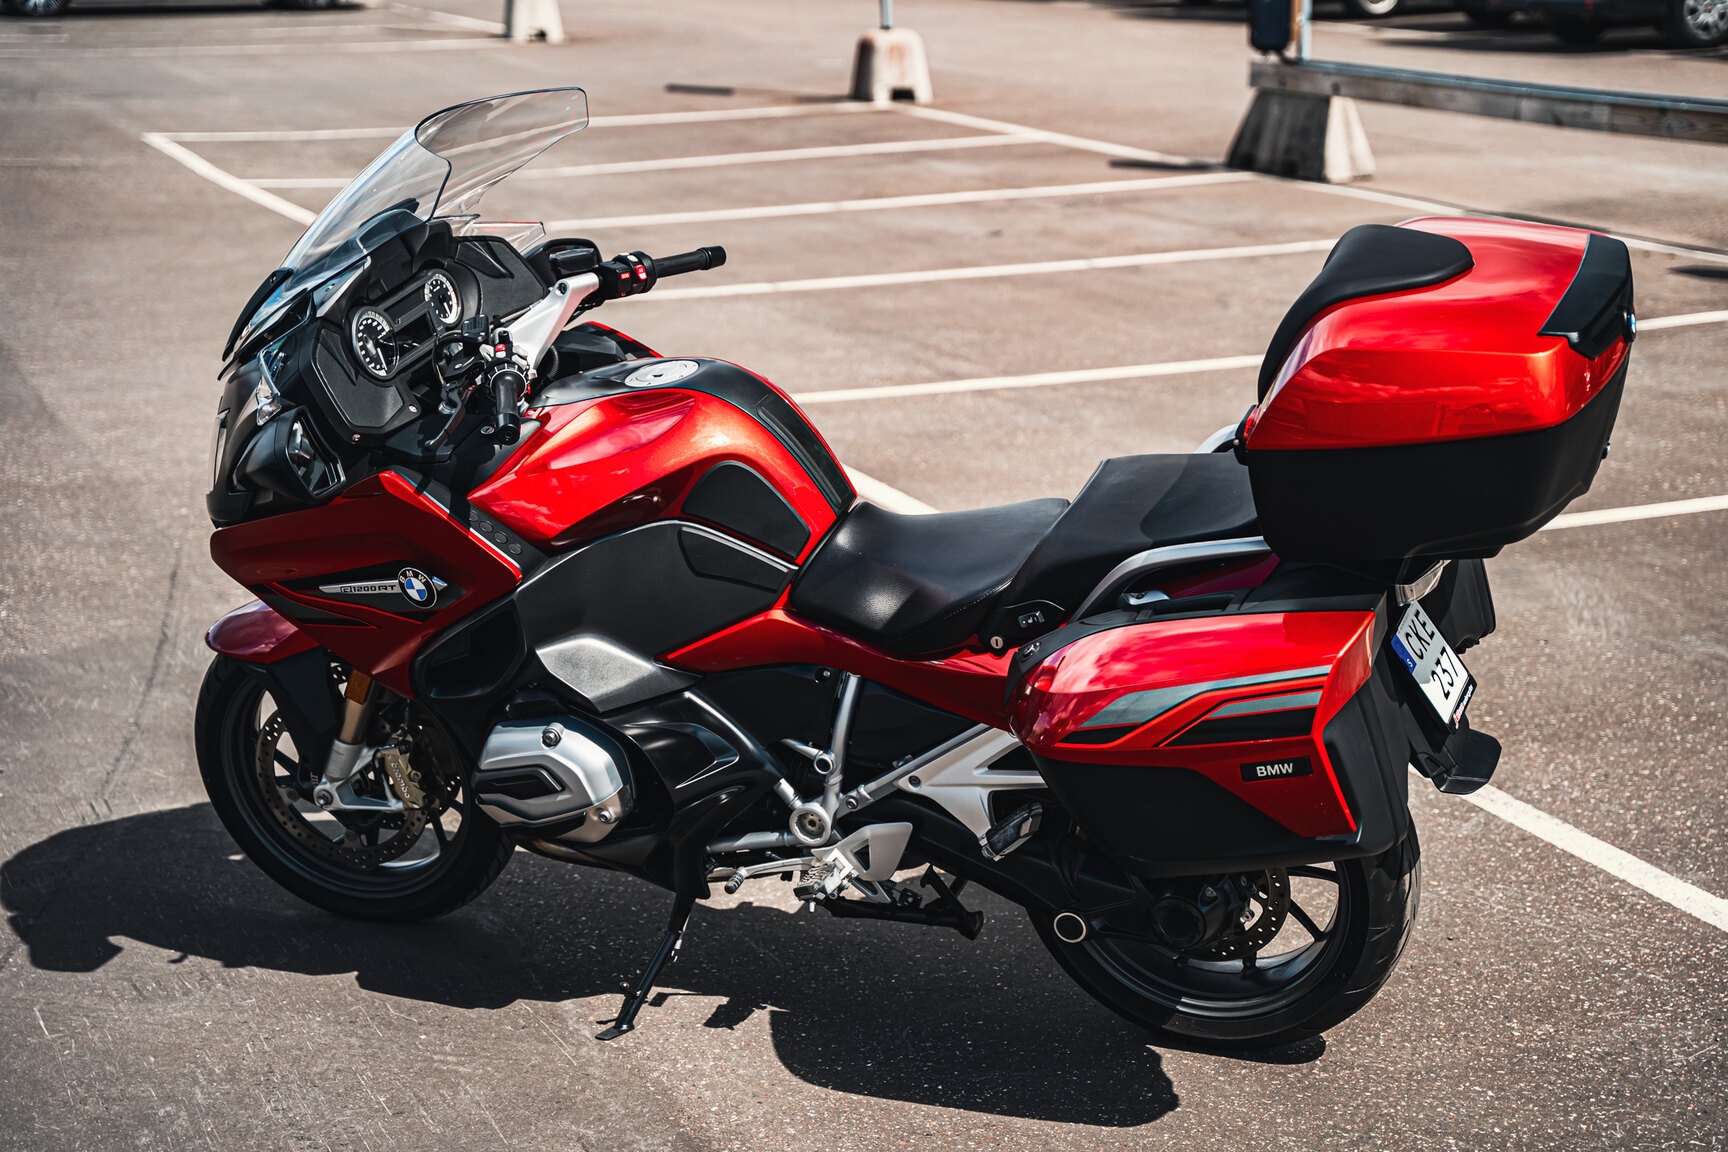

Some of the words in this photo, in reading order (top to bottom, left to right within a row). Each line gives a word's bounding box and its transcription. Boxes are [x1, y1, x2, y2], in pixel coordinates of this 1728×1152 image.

[1405, 609, 1435, 660] CKE
[1406, 658, 1413, 668] S
[1431, 646, 1459, 700] 237
[391, 762, 410, 799] brembo
[1256, 763, 1293, 777] BMW
